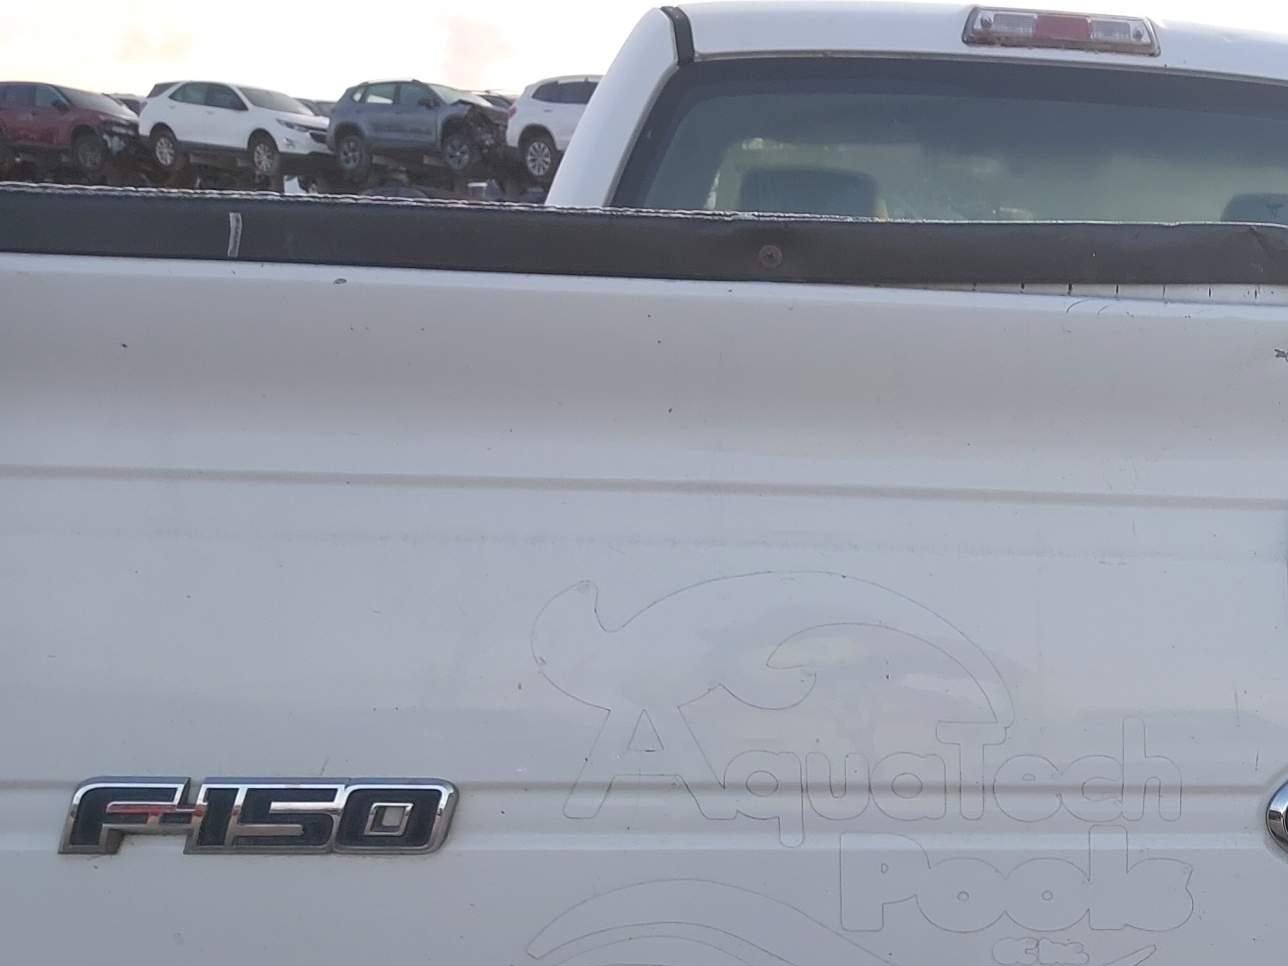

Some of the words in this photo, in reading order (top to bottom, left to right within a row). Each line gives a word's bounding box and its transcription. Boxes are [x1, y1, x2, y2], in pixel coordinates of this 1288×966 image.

[57, 775, 461, 855] F-150
[562, 700, 1184, 848] AquaTech
[839, 824, 1195, 933] Pools
